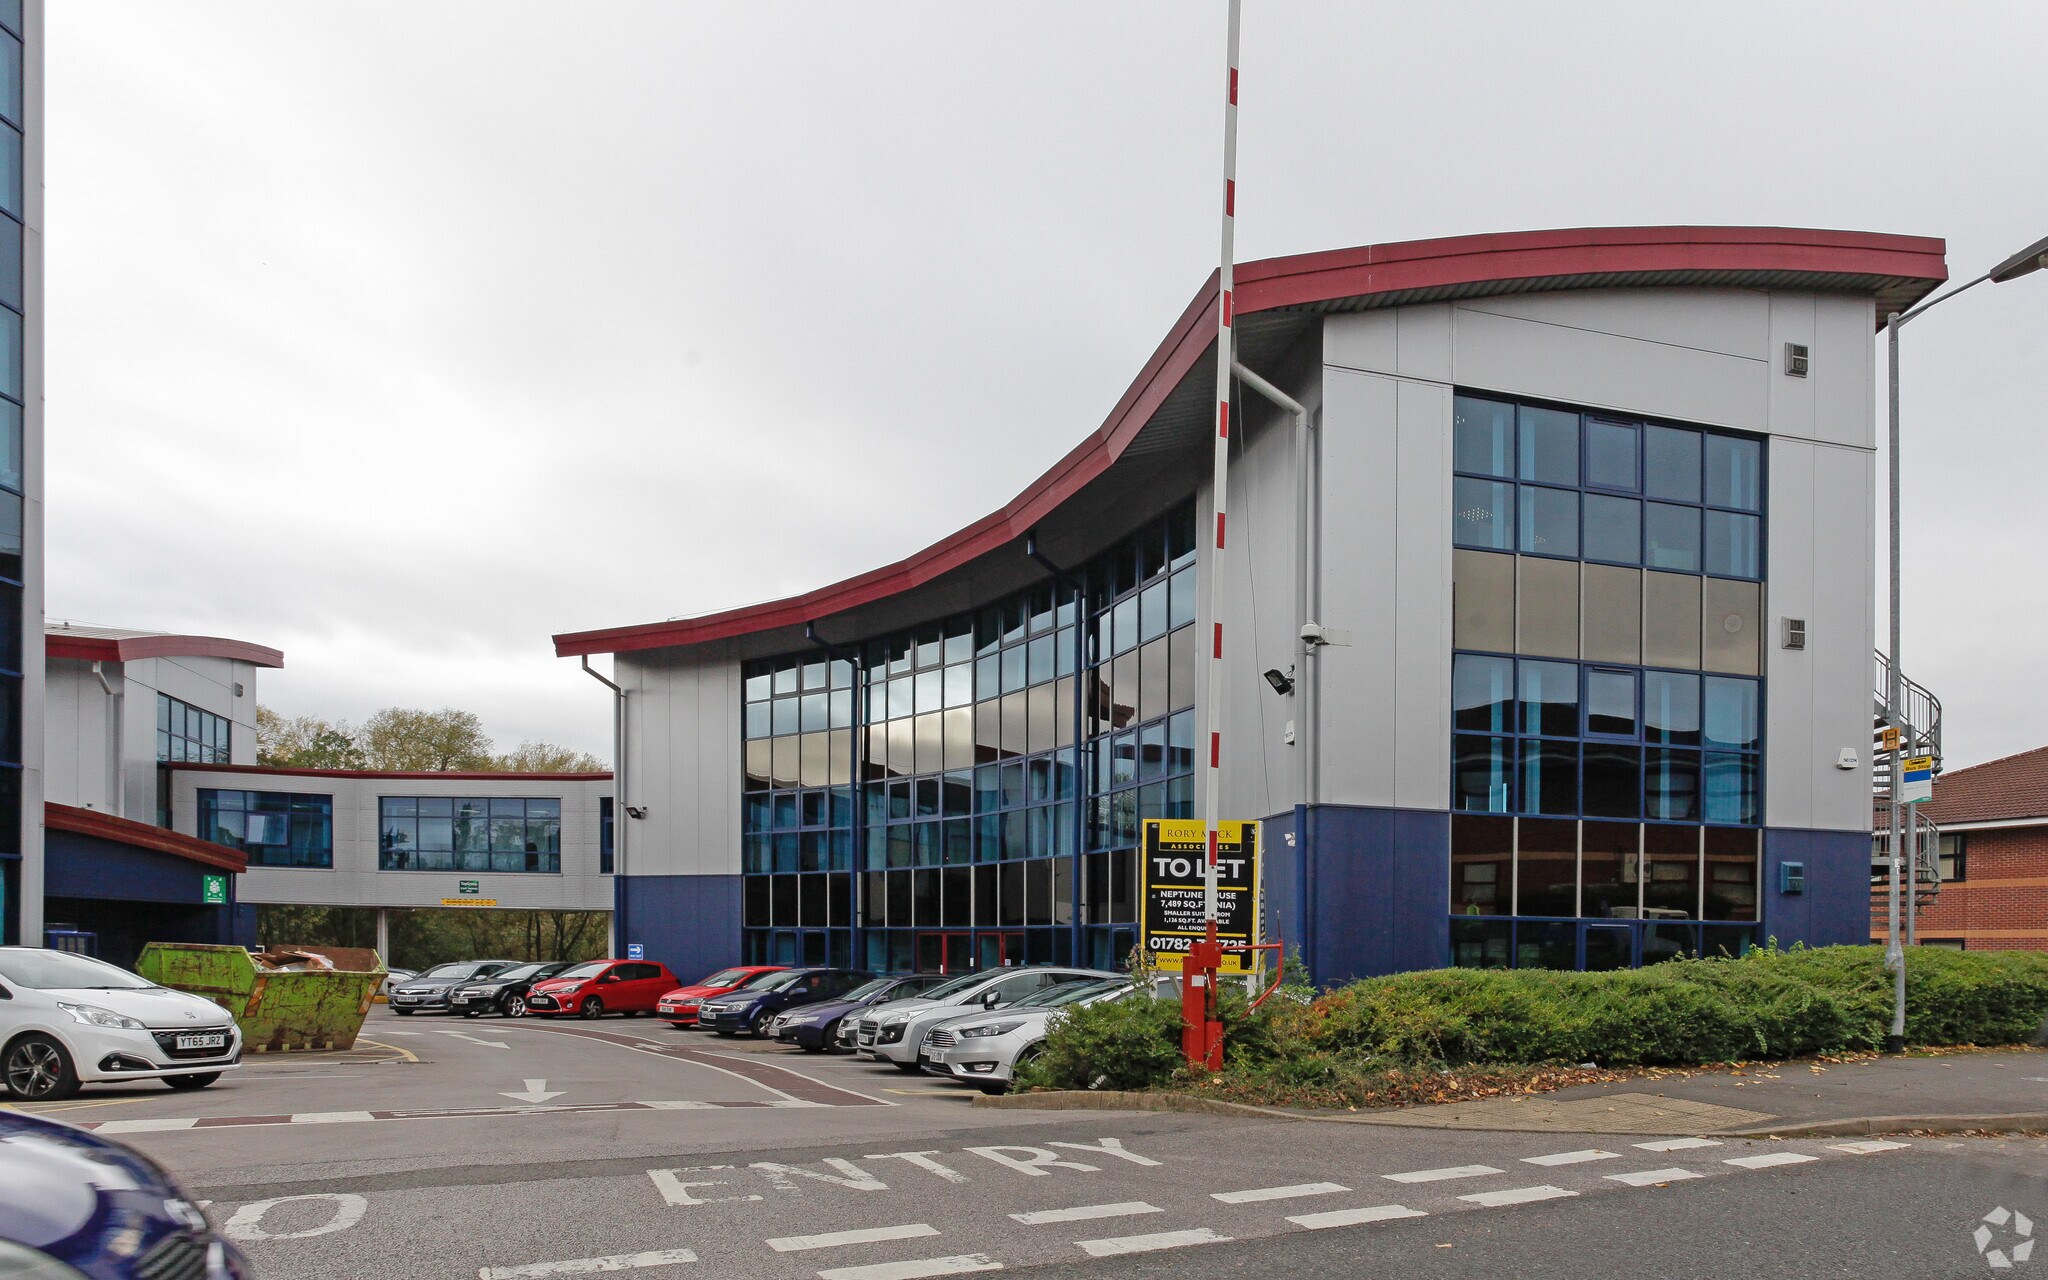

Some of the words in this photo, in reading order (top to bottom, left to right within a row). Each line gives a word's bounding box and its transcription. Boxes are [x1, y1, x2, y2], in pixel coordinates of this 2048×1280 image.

[1167, 829, 1197, 838] RORY
[1201, 829, 1233, 839] MCK
[1153, 857, 1191, 877] TO
[1160, 890, 1203, 899] NEPTUNE
[1160, 899, 1182, 908] 7,489
[1217, 902, 1236, 911] NIA)
[1150, 937, 1192, 950] 01782
[180, 1036, 204, 1047] YT65
[206, 1035, 221, 1046] JRZ
[646, 1137, 1164, 1207] ENTRY
